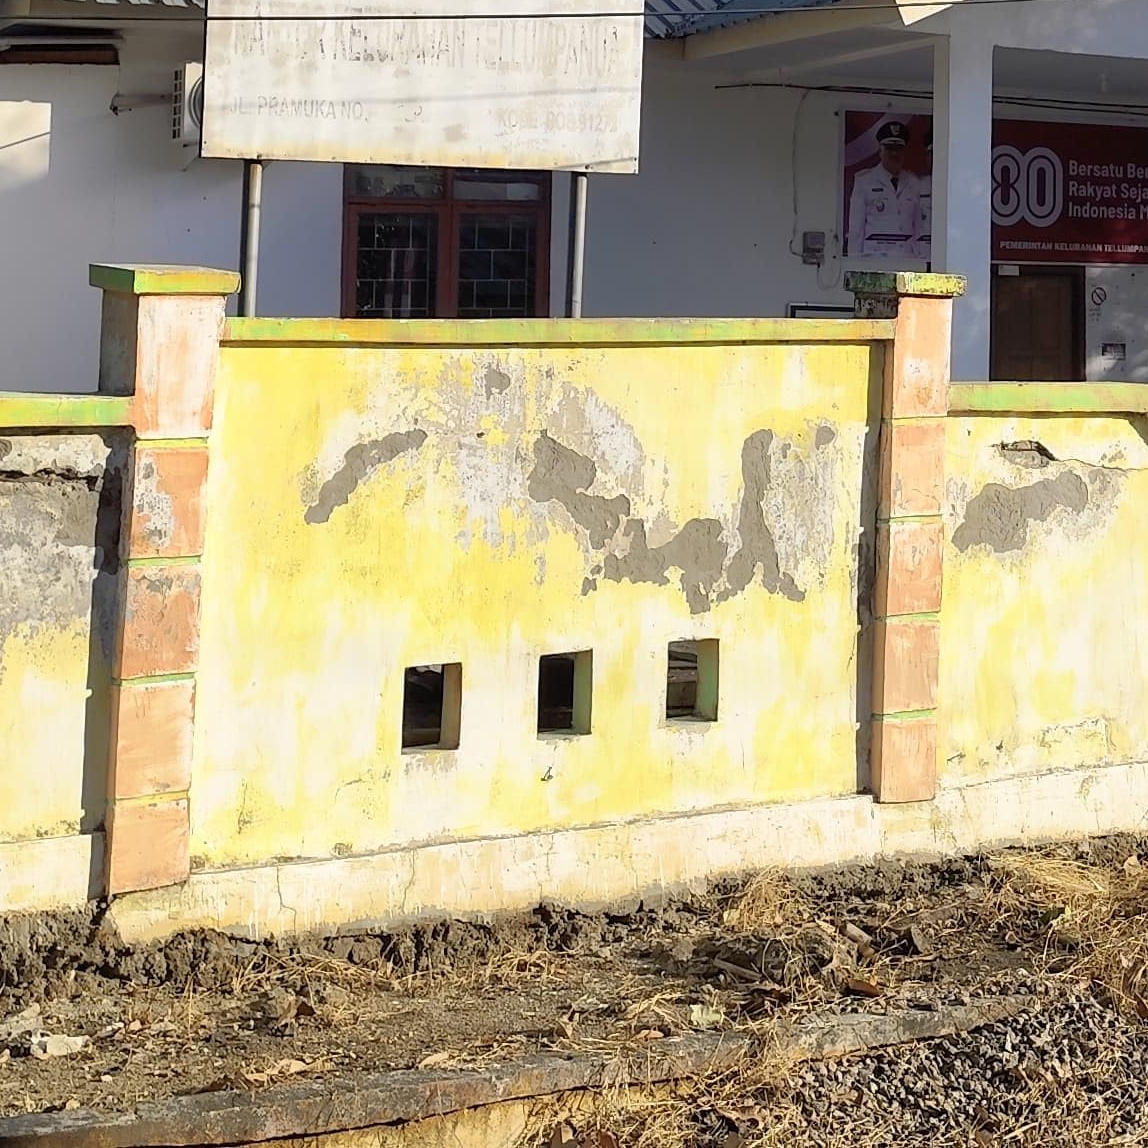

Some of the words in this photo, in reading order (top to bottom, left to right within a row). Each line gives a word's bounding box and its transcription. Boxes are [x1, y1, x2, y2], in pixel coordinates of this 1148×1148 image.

[257, 95, 337, 119] PRAMUKA
[1069, 160, 1123, 179] Bersatu
[991, 145, 1063, 227] 80
[1069, 181, 1117, 200] Rakyat
[1069, 202, 1136, 220] Indonesia
